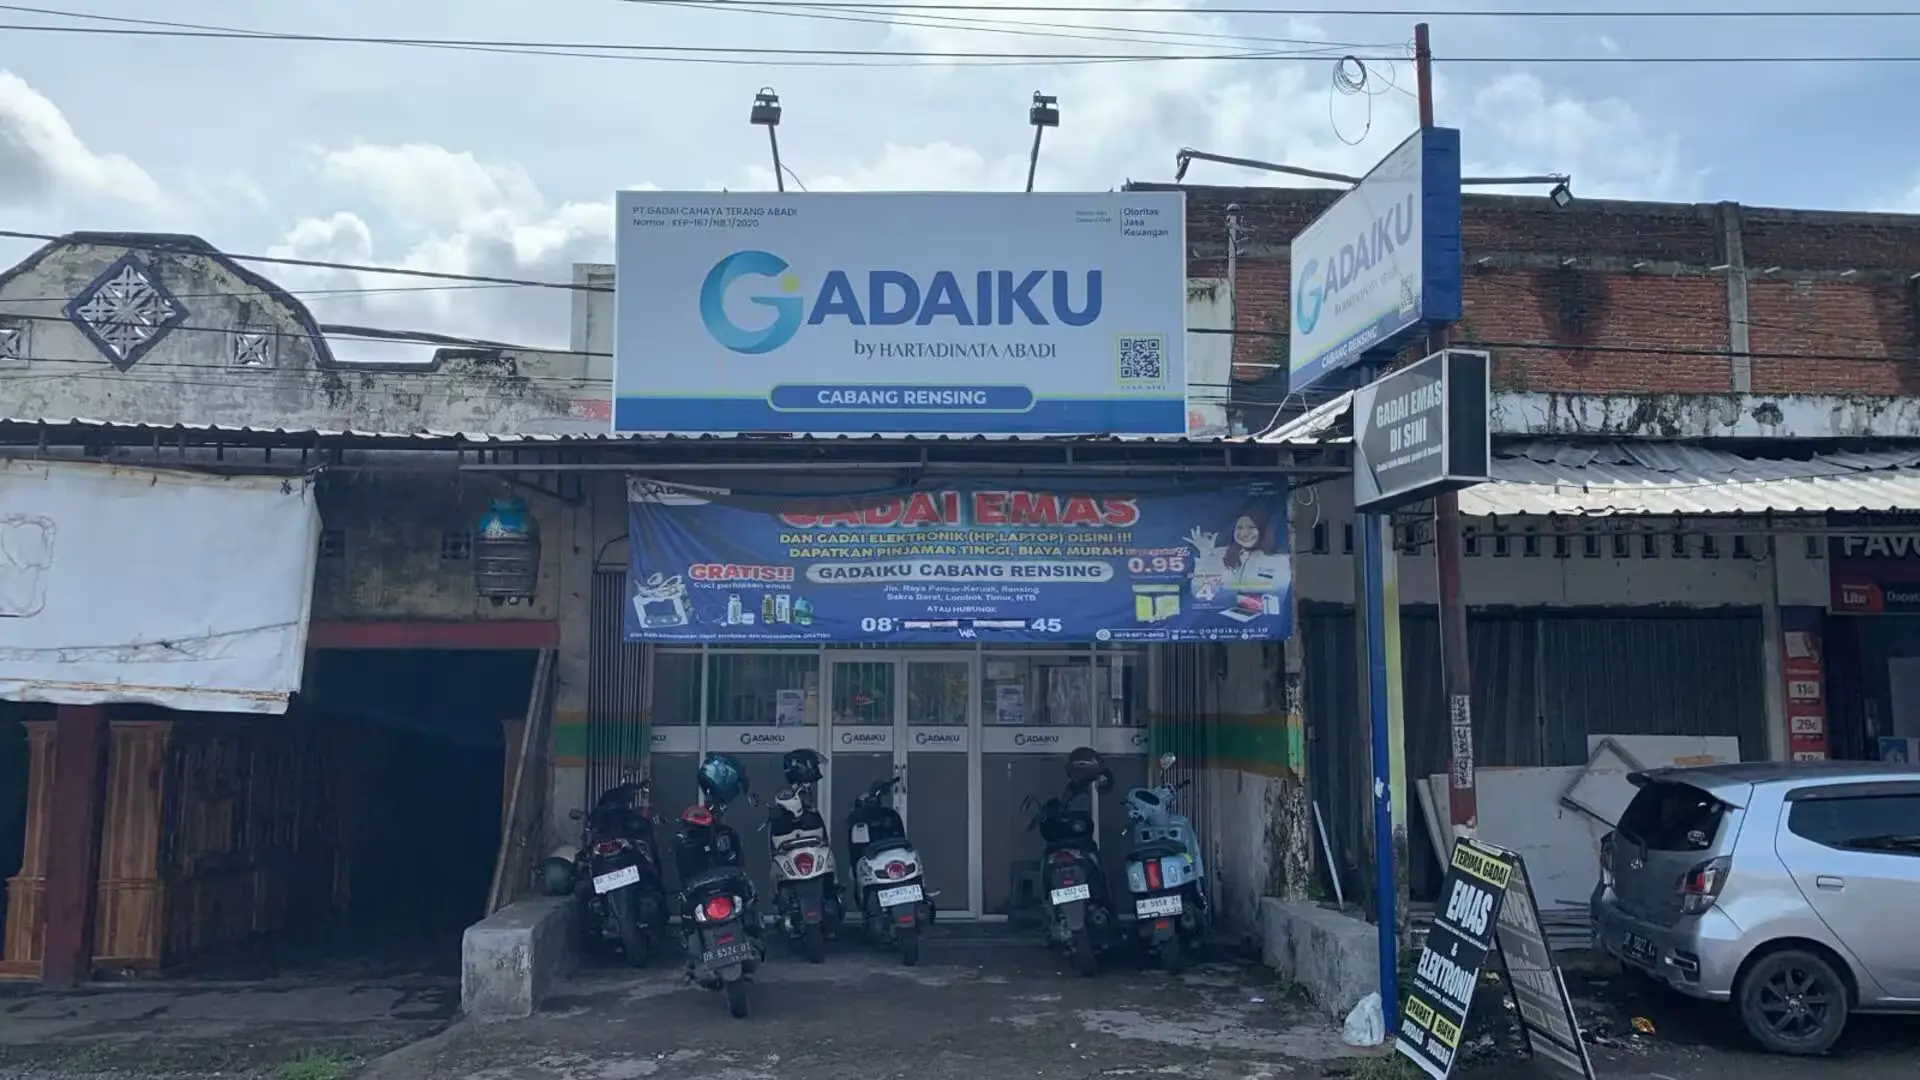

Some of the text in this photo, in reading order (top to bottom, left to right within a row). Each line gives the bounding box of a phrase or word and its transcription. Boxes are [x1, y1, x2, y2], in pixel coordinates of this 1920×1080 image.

[680, 206, 723, 216] CAHAYA
[726, 207, 765, 217] TERANG
[767, 207, 797, 217] ABADI
[1123, 218, 1145, 227] Jasa
[1123, 228, 1169, 239] Keuangan
[1296, 193, 1414, 336] GADAIKU
[699, 249, 1103, 355] GADAIKU
[853, 338, 1056, 360] by HARTADINATA ABADI
[816, 389, 987, 406] CABANG RENSING
[1375, 379, 1443, 428] GADAI EMAS
[1390, 416, 1427, 453] DI SINI
[972, 489, 1141, 528] EMAS
[779, 533, 813, 544] DAN
[816, 533, 866, 544] GADAI
[869, 531, 966, 544] ELEKTRONIK
[1067, 532, 1113, 543] DISINI
[789, 547, 873, 558] DAPATKAN
[876, 545, 956, 557] PINJAMAN
[1018, 546, 1063, 556] BIAYA
[818, 564, 1102, 579] GADAIKU CABANG RENSING
[1127, 557, 1185, 573] 0.95
[926, 605, 951, 613] ATAU
[1031, 617, 1063, 633] 45
[957, 627, 978, 639] WA
[740, 733, 785, 745] GADAIKU
[841, 732, 886, 744] GADAIKU
[916, 732, 960, 745] GADAIKU
[1014, 733, 1058, 745] GADAIKU
[1454, 848, 1509, 886] TERIMA GADAI
[1445, 879, 1494, 937] EMAS
[1450, 942, 1459, 957] &
[1407, 999, 1431, 1024] SYARAT
[1435, 1018, 1457, 1043] BIAYA
